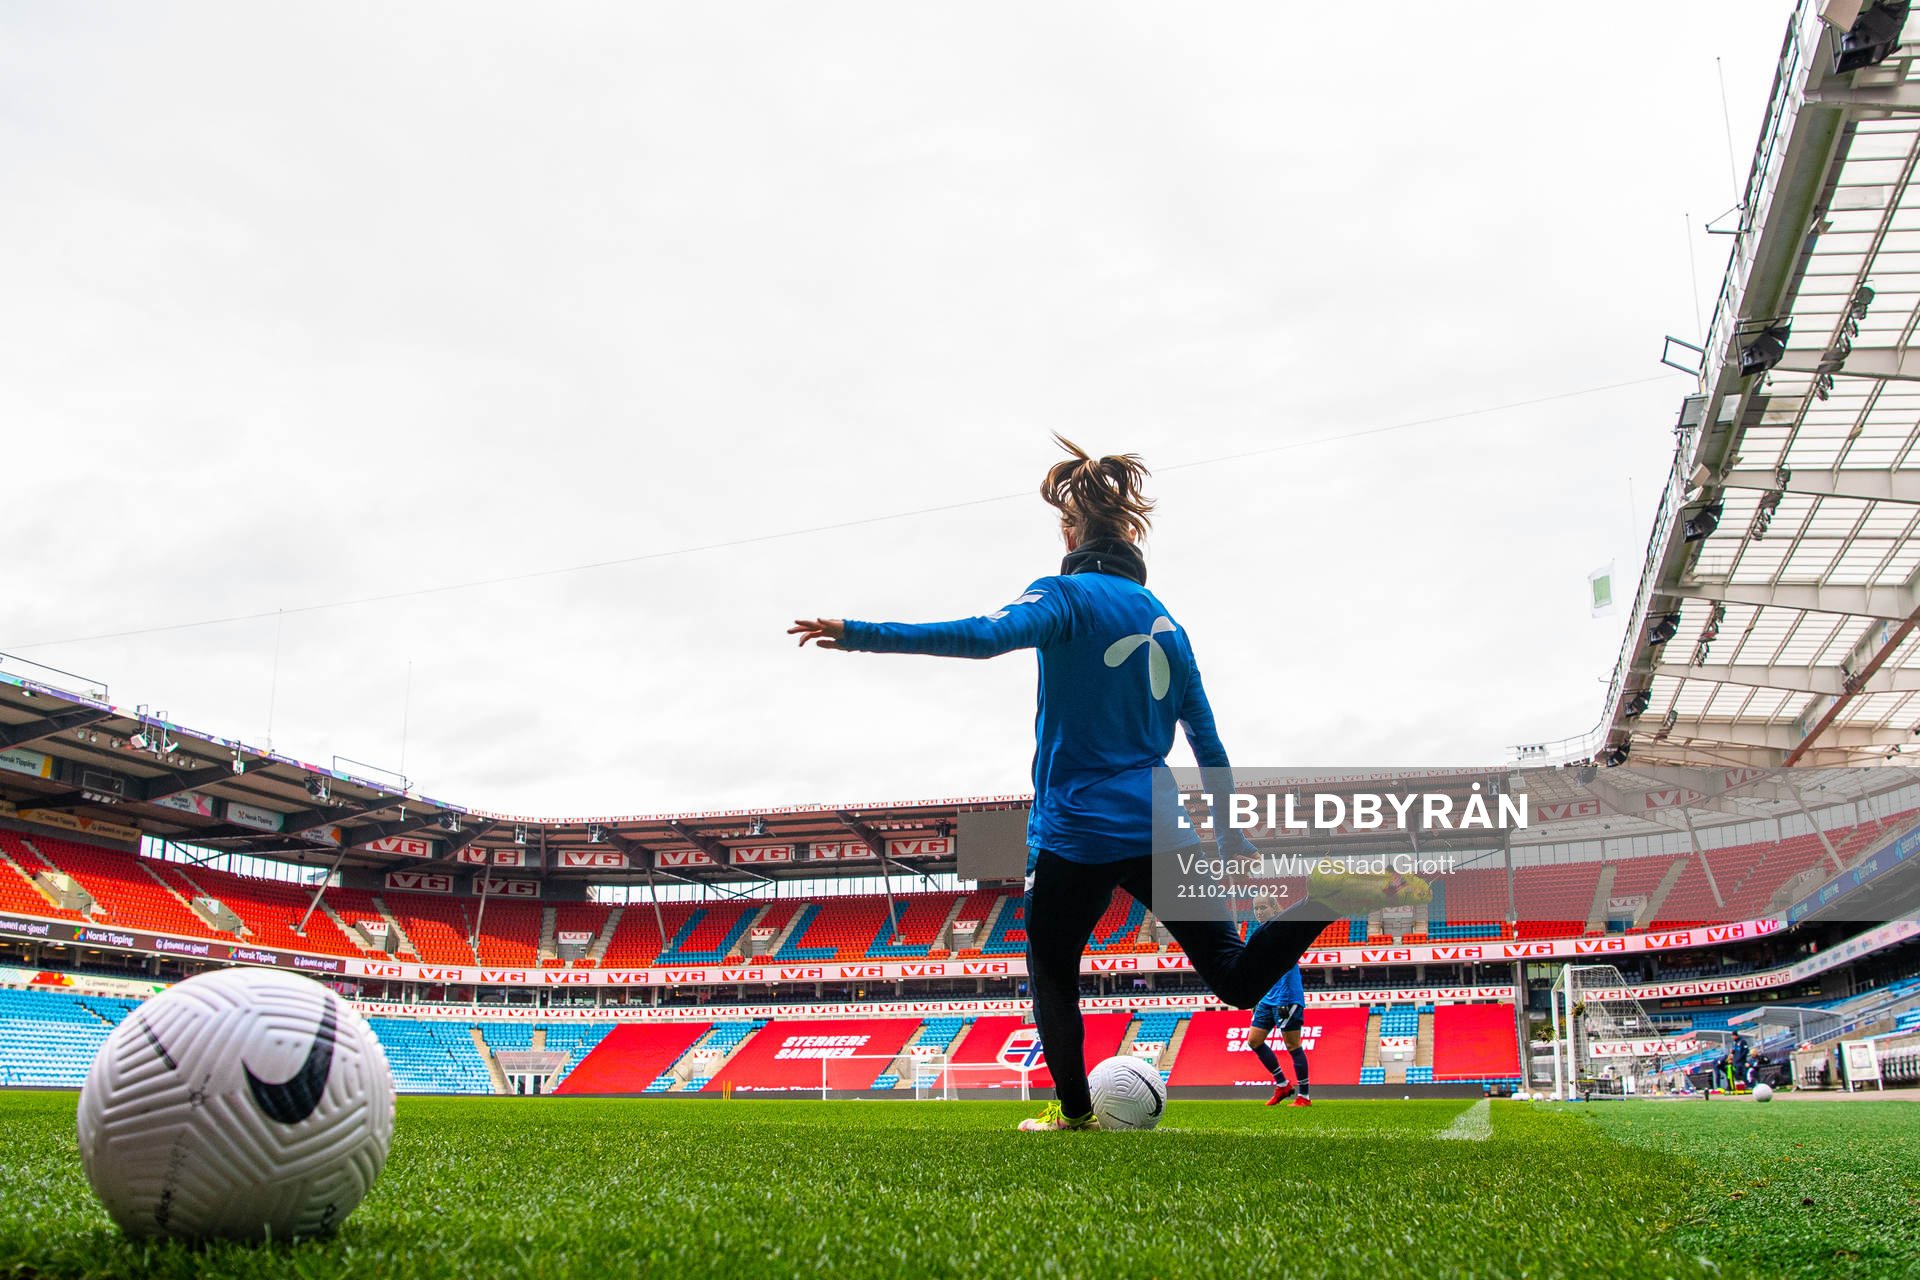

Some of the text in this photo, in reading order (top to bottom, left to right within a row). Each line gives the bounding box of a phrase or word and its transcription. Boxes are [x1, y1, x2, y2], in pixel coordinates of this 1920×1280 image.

[1538, 800, 1600, 821] VG
[372, 838, 427, 854] VG
[816, 843, 871, 859] VG
[891, 839, 949, 855] VG
[463, 848, 519, 865] VG
[565, 852, 623, 866] VG
[661, 851, 714, 866] VG
[735, 848, 790, 863] VG
[389, 873, 449, 890] VG
[476, 879, 537, 896] VG
[359, 921, 386, 931] VG
[751, 928, 775, 937] VG
[952, 921, 978, 930] VG
[562, 932, 590, 940] VG
[86, 930, 107, 941] Norsk
[108, 933, 134, 947] Tipping
[238, 949, 255, 960] Norsk
[256, 952, 277, 964] Tipping
[364, 964, 401, 976] VG
[419, 968, 462, 980] VG
[481, 971, 526, 982] VG
[545, 972, 589, 983] VG
[608, 972, 648, 983] VG
[665, 971, 705, 982] VG
[723, 970, 763, 980] VG
[781, 968, 822, 979] VG
[841, 966, 882, 977] VG
[902, 964, 944, 976] VG
[964, 963, 1008, 974] VG
[1092, 958, 1137, 970] VG
[1298, 952, 1341, 963] VG
[1362, 950, 1410, 962] VG
[1432, 946, 1482, 959] VG
[1504, 943, 1554, 957] VG
[1576, 939, 1625, 953] VG
[1646, 932, 1691, 948] VG
[1708, 924, 1744, 942] VG
[1585, 989, 1621, 1000] VG
[1625, 986, 1659, 998] VG
[1662, 985, 1696, 996] VG
[1699, 982, 1727, 993] VG
[1730, 979, 1754, 990] VG
[1756, 975, 1777, 988] VG
[370, 1004, 397, 1012] VG
[403, 1006, 430, 1014] VG
[436, 1007, 466, 1015] VG
[472, 1008, 502, 1016] VG
[679, 1008, 706, 1016] VG
[777, 1006, 805, 1014] VG
[913, 1003, 942, 1011] VG
[948, 1002, 978, 1010] VG
[984, 1001, 1013, 1009] VG
[1092, 999, 1122, 1007] VG
[1204, 996, 1222, 1004] V
[1320, 993, 1351, 1001] VG
[1358, 992, 1390, 1000] VG
[1398, 990, 1430, 998] VG
[1438, 989, 1470, 997] VG
[1478, 988, 1512, 996] VG
[782, 1035, 871, 1047] STERKERE
[1133, 1043, 1163, 1051] VG
[1381, 1038, 1415, 1047] VG
